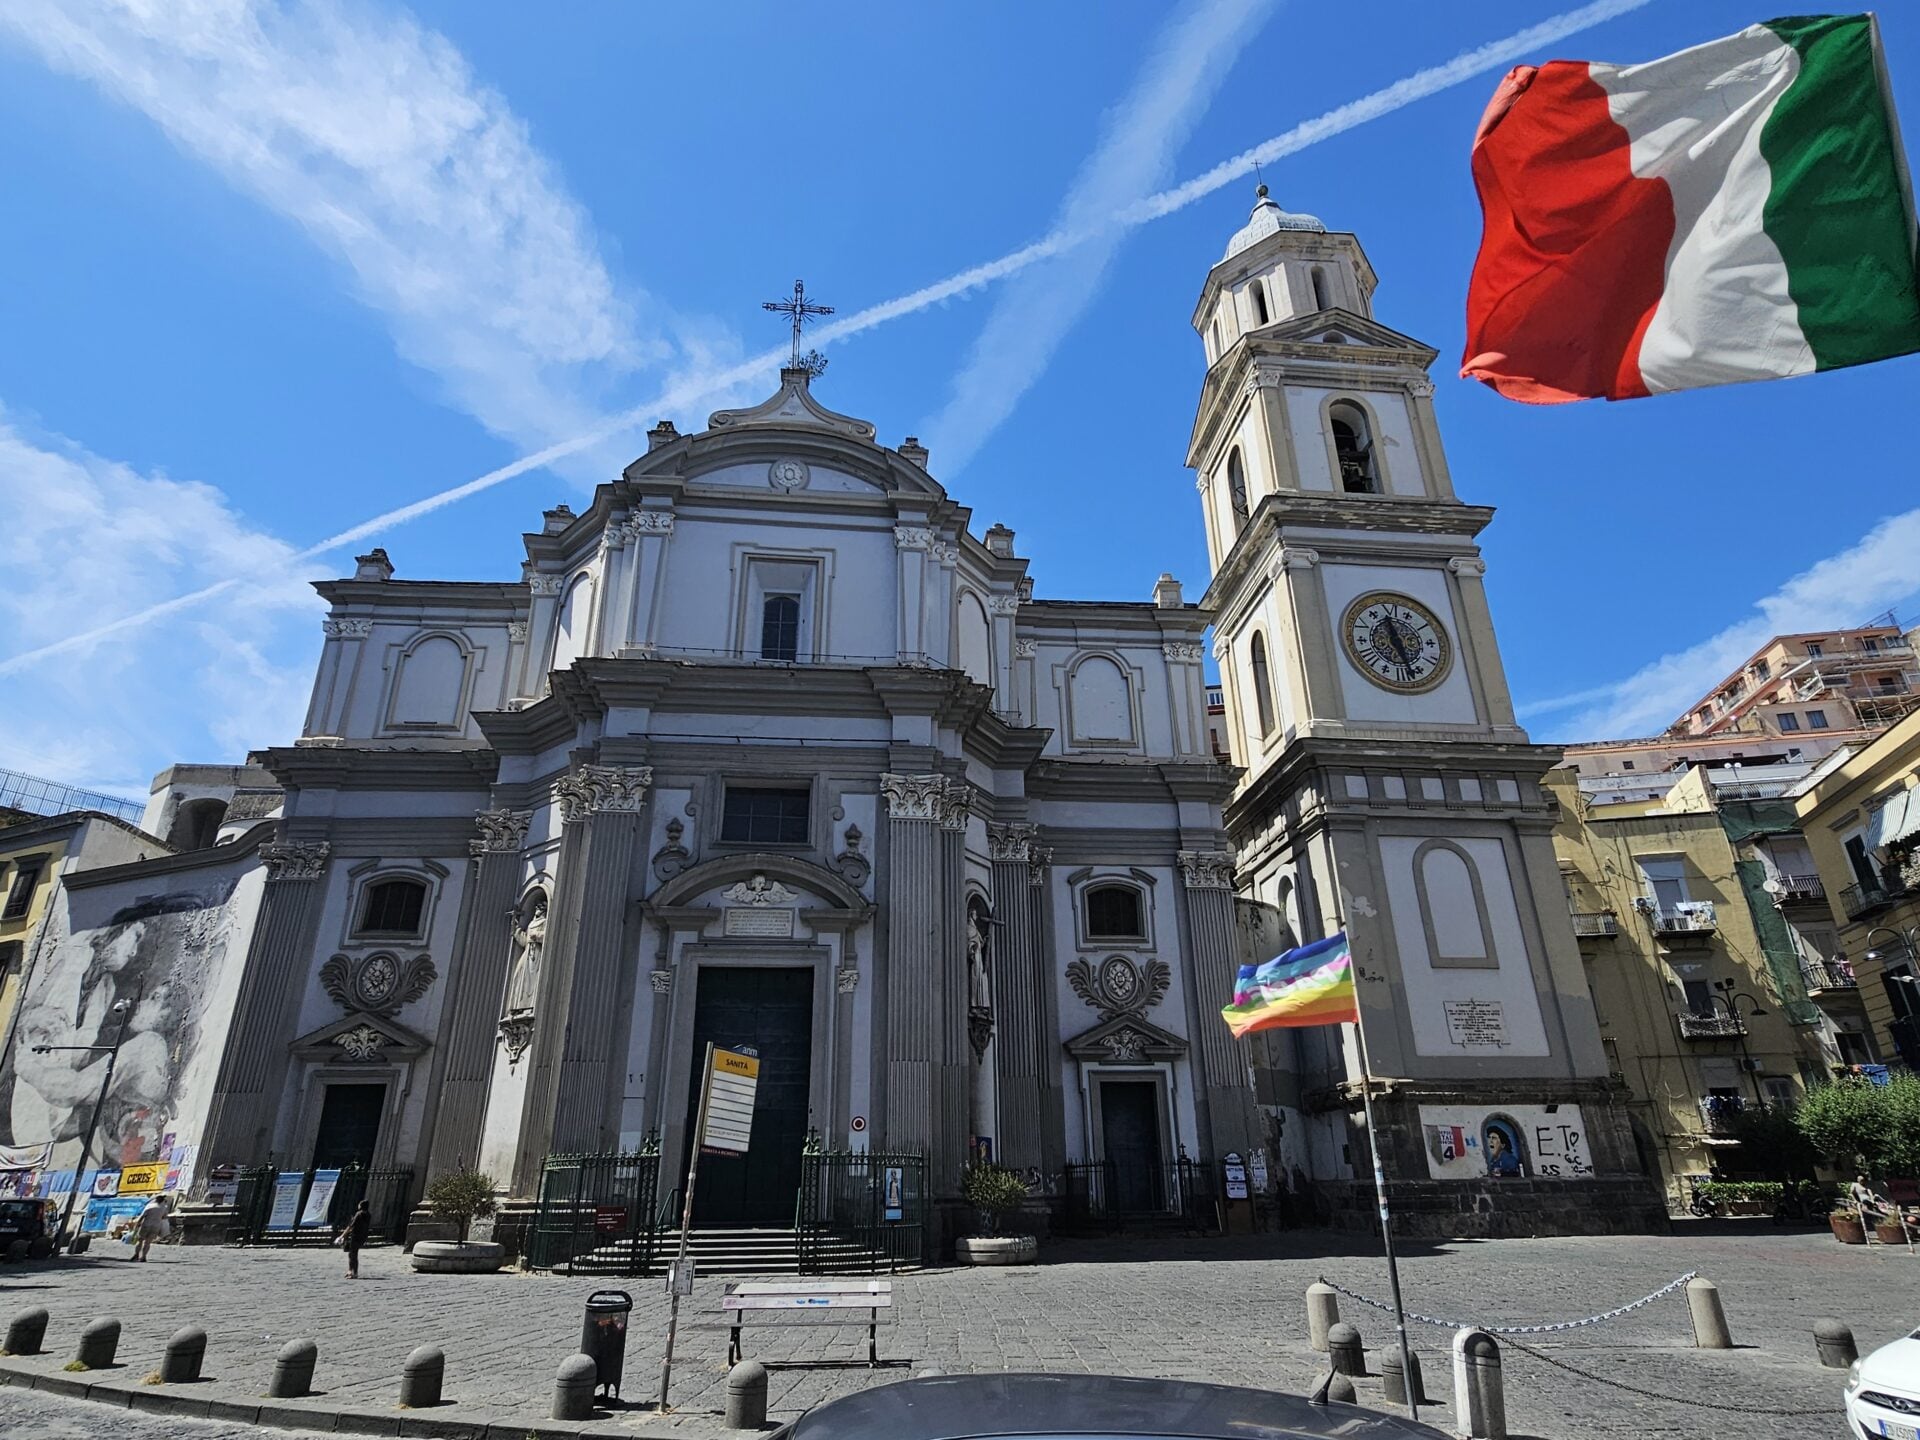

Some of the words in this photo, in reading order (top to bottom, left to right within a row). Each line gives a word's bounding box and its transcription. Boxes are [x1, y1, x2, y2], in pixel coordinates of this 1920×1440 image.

[742, 1046, 758, 1057] anm
[1443, 1145, 1456, 1161] 4
[127, 1172, 152, 1184] CERES
